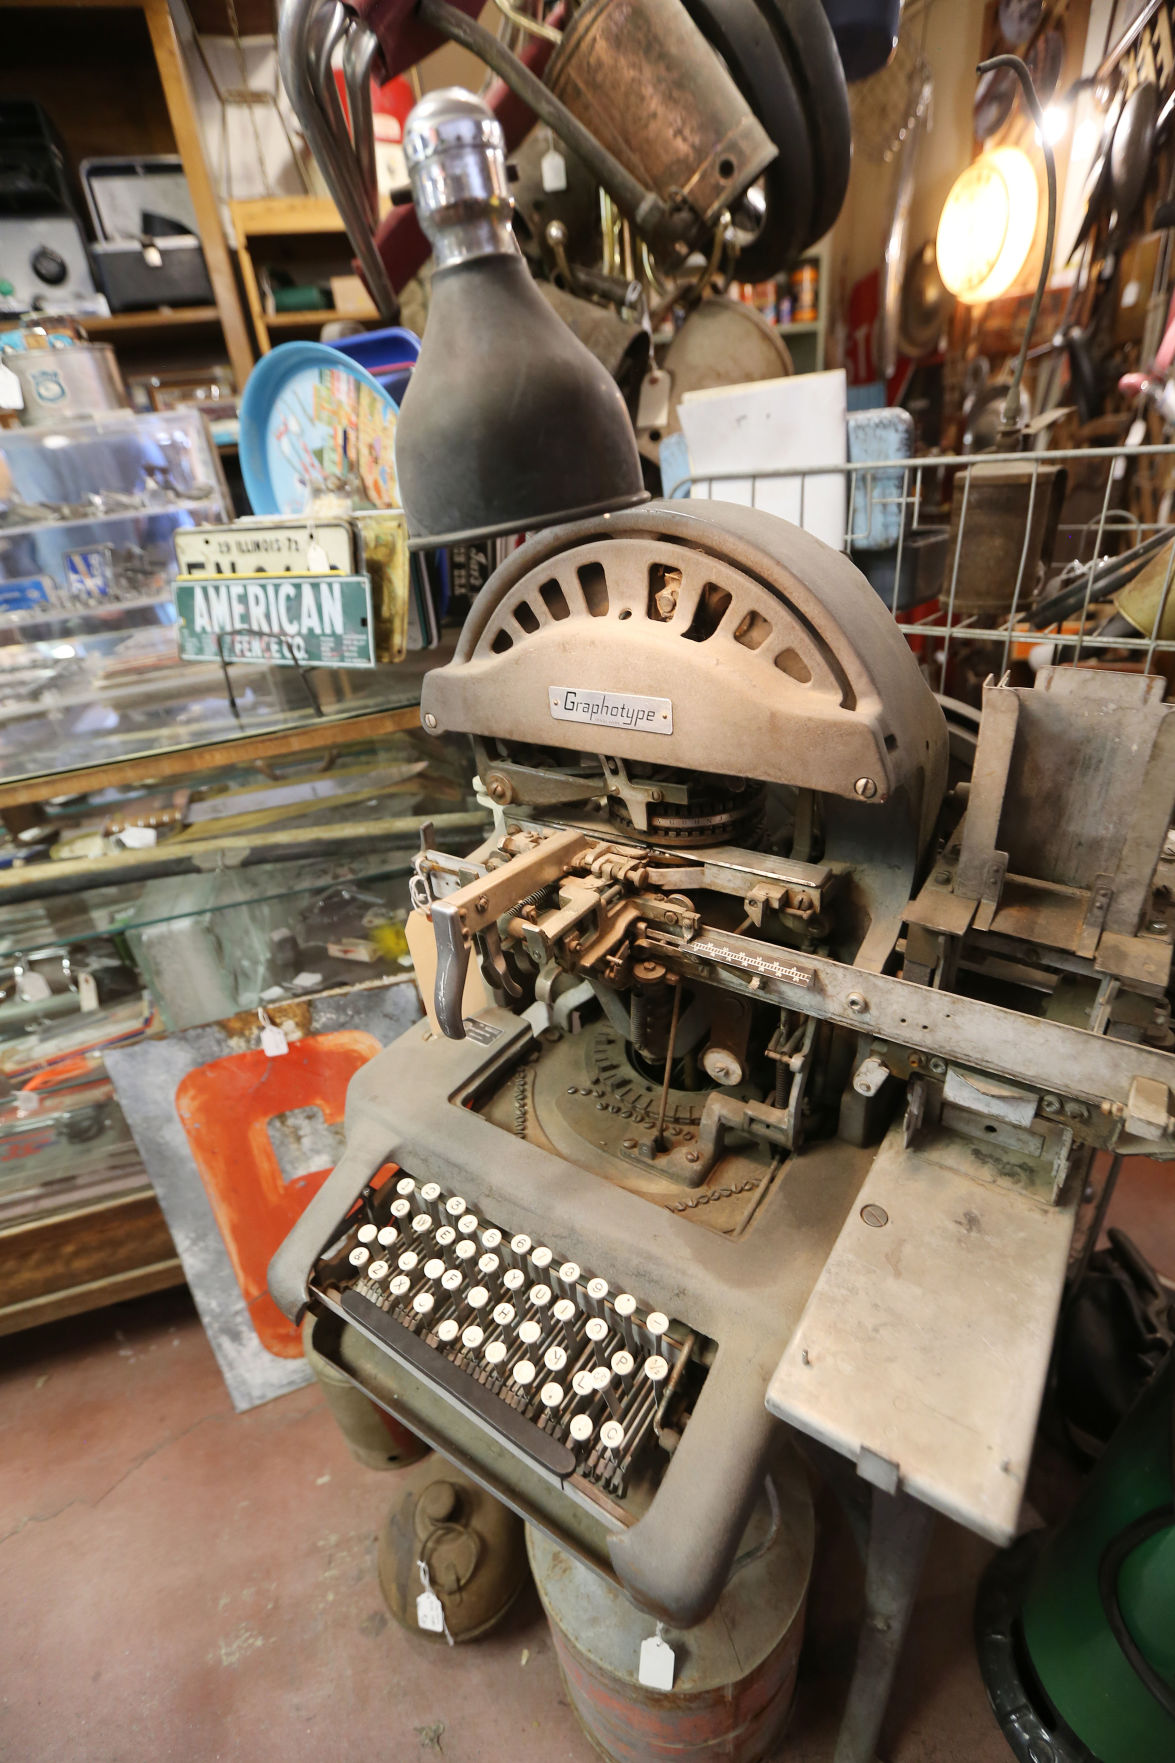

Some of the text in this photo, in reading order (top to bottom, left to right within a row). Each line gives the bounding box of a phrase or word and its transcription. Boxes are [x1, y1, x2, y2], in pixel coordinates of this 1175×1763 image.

[235, 538, 282, 554] ILLINOIS
[193, 582, 345, 635] AMERICAN
[233, 635, 282, 660] FENCE
[563, 691, 656, 727] Graphotype
